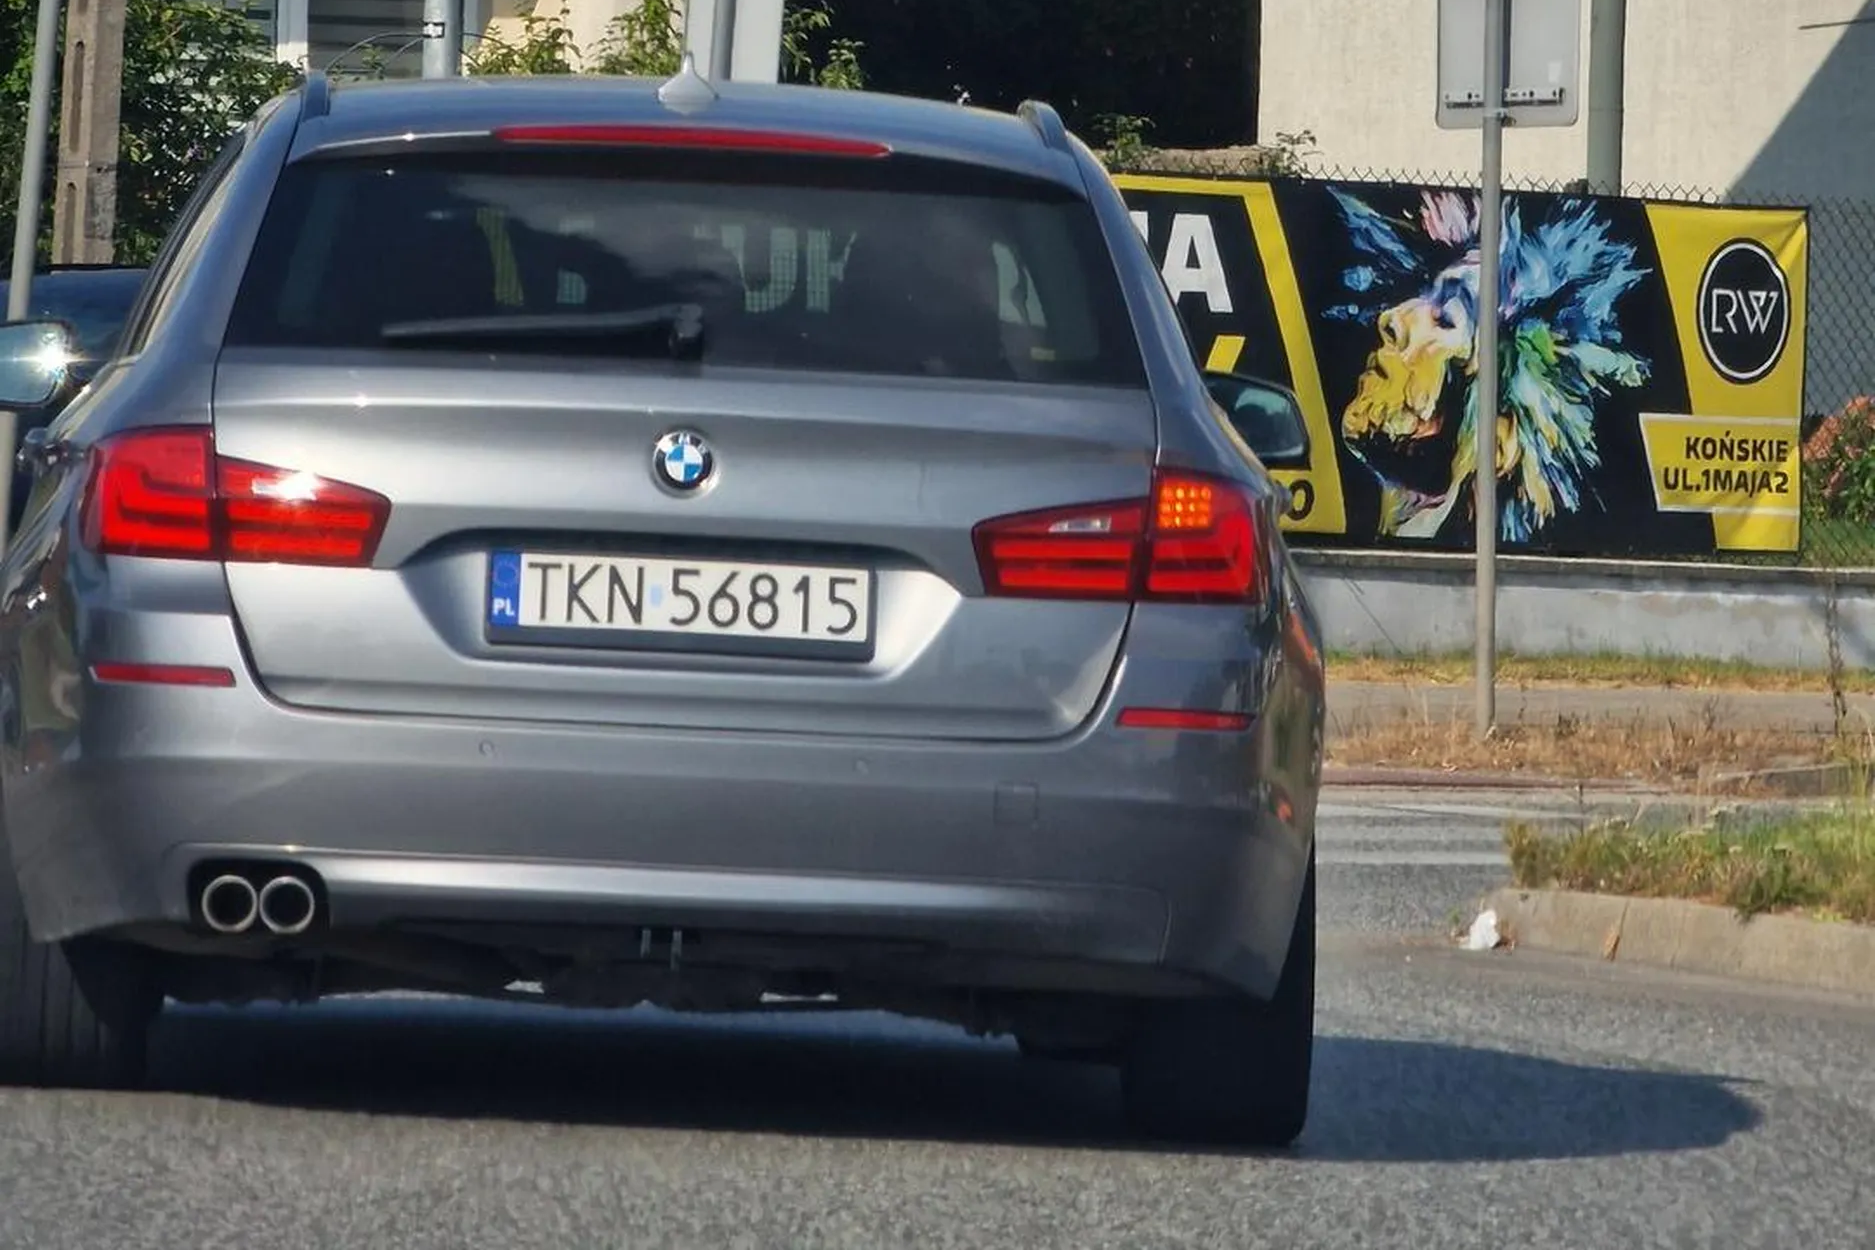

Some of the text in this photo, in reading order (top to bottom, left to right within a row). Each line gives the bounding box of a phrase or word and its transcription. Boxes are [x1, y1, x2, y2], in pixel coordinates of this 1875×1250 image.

[1710, 287, 1780, 335] RW
[1684, 430, 1790, 463] KOŃSKIE
[492, 598, 516, 617] PL
[527, 561, 858, 636] TKN 56815
